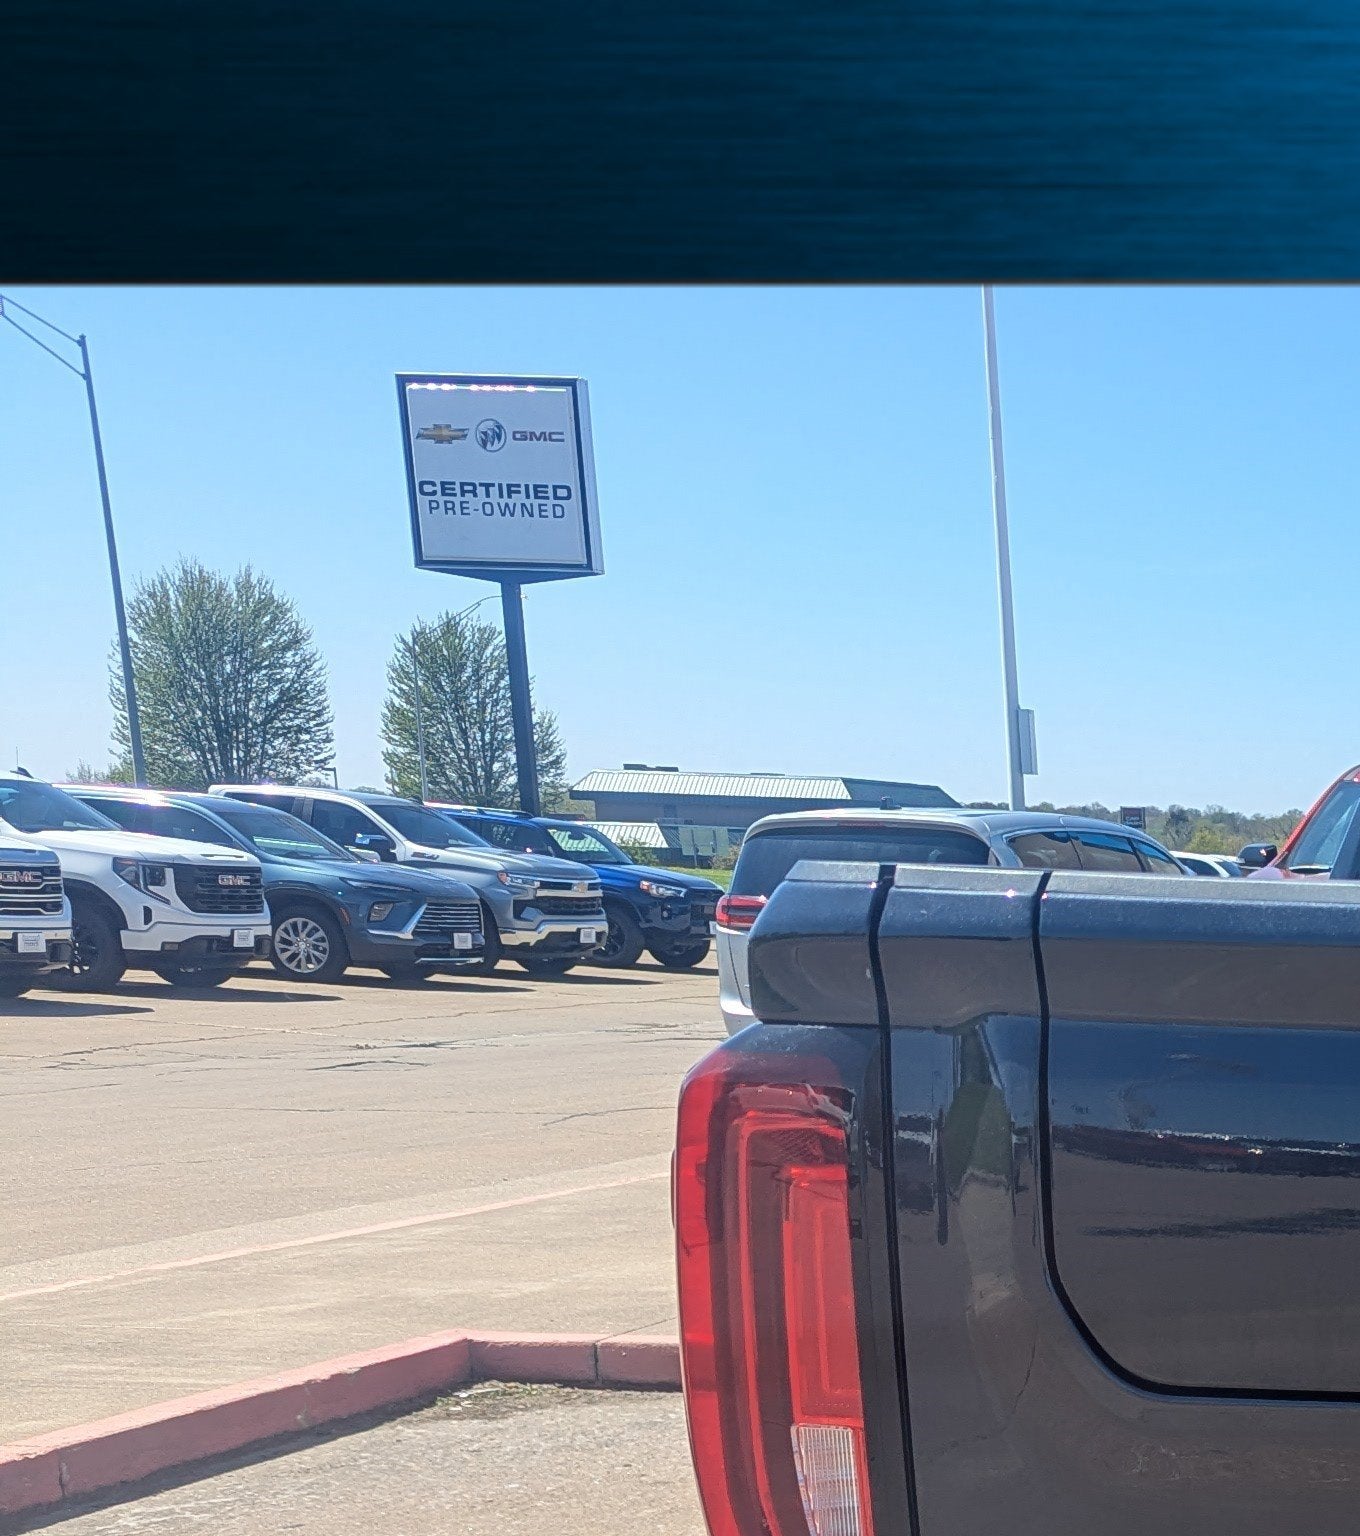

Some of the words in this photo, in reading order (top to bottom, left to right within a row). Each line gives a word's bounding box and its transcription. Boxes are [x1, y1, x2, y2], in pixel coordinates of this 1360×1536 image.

[511, 430, 565, 442] GMC
[418, 480, 573, 501] CERTIFIED
[428, 499, 565, 519] PRE-OWNED
[0, 870, 42, 883] GMC
[218, 874, 251, 886] GMC
